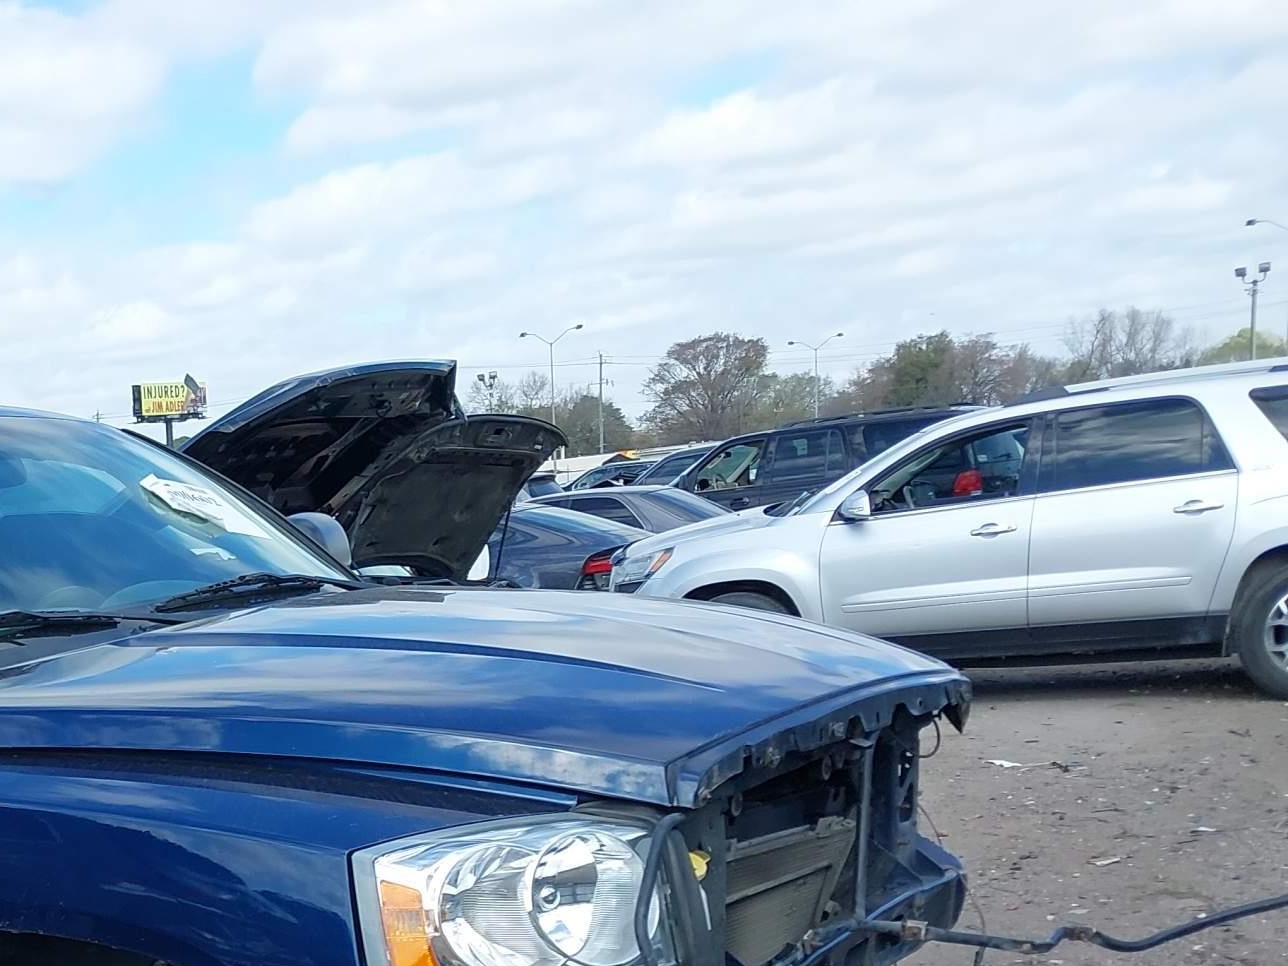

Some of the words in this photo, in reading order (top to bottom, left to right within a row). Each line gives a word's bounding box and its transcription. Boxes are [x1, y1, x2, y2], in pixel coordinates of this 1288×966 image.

[143, 385, 185, 399] INJURED?
[152, 401, 164, 413] JIM
[166, 400, 184, 412] ADLER
